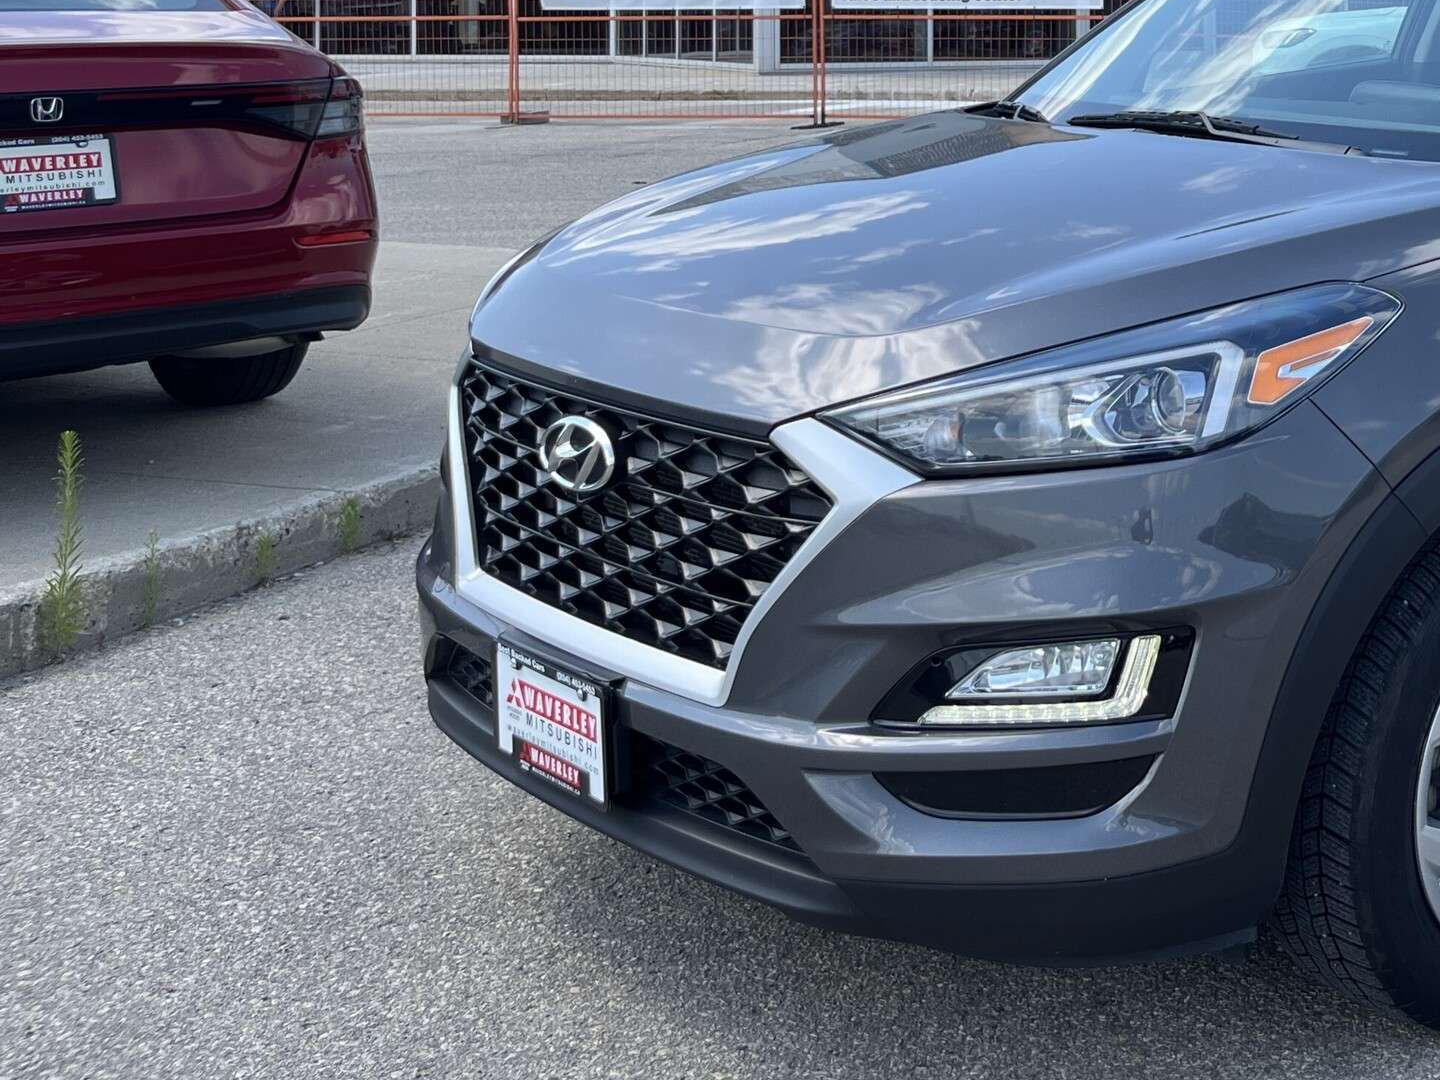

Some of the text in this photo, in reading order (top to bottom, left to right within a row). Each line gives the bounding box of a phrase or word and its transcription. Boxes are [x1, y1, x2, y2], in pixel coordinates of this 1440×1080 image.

[2, 153, 100, 173] WAVERLEY
[6, 168, 103, 184] MITSUBISHI
[20, 189, 84, 204] WAVERLEY
[523, 685, 598, 739] WAVERLEY
[526, 712, 598, 760] MITSUBISHI
[530, 745, 581, 786] WAVERLEY
